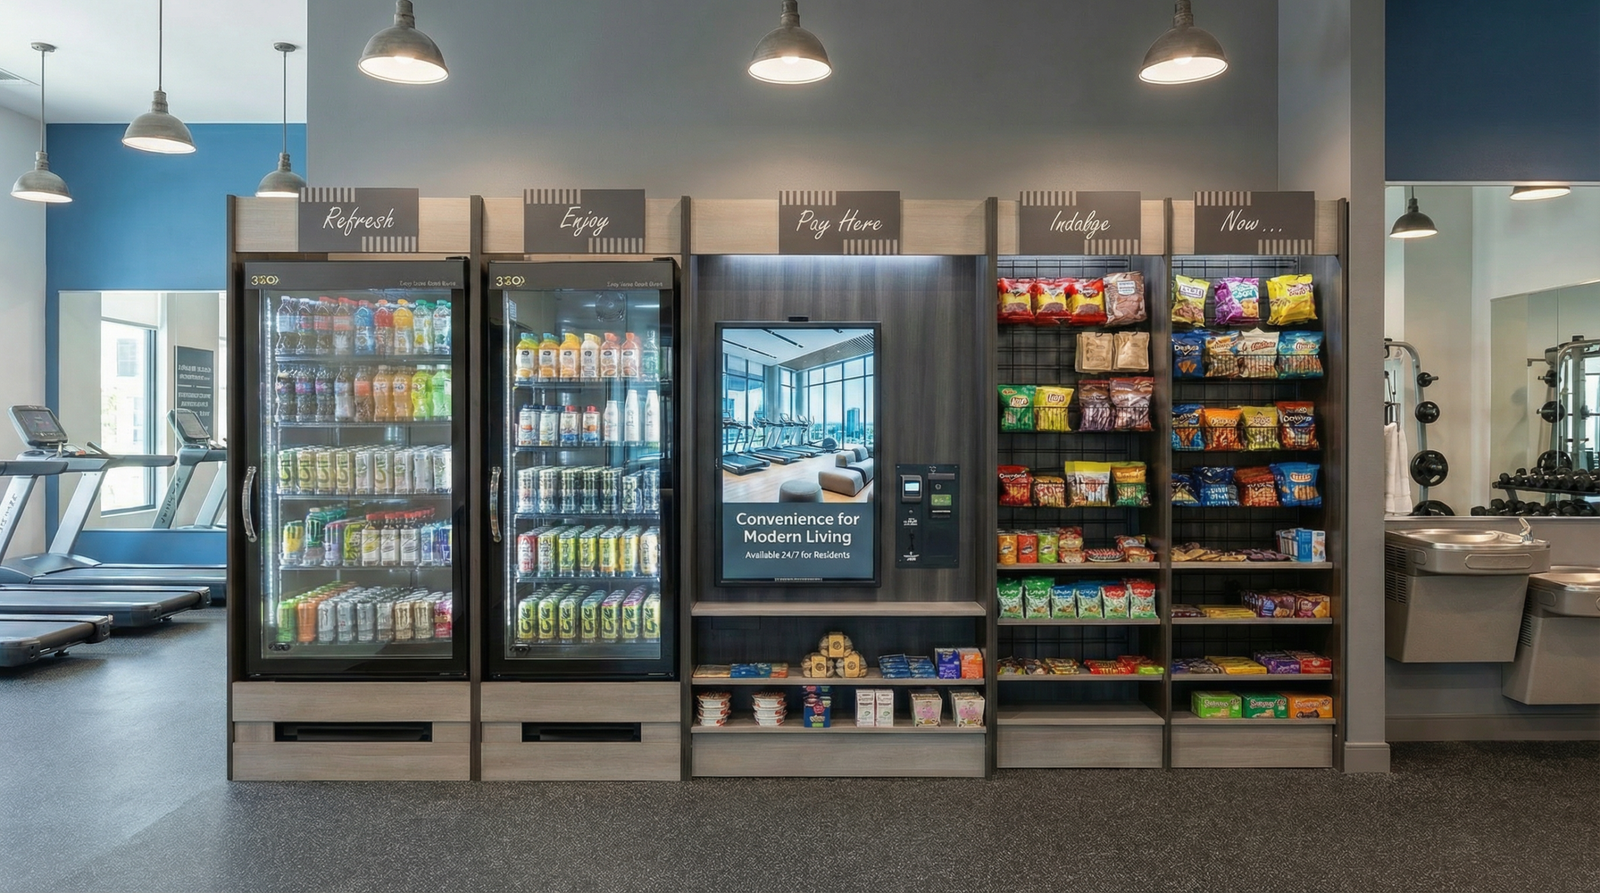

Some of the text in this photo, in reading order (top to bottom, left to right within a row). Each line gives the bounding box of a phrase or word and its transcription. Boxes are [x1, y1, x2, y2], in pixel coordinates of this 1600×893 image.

[322, 206, 396, 236] Refresh
[559, 205, 610, 237] Enjoy
[796, 208, 883, 240] Pay Here
[736, 512, 860, 526] Convenience for
[744, 530, 852, 546] Modern Living
[745, 550, 851, 560] Available 24/7 for Residents
